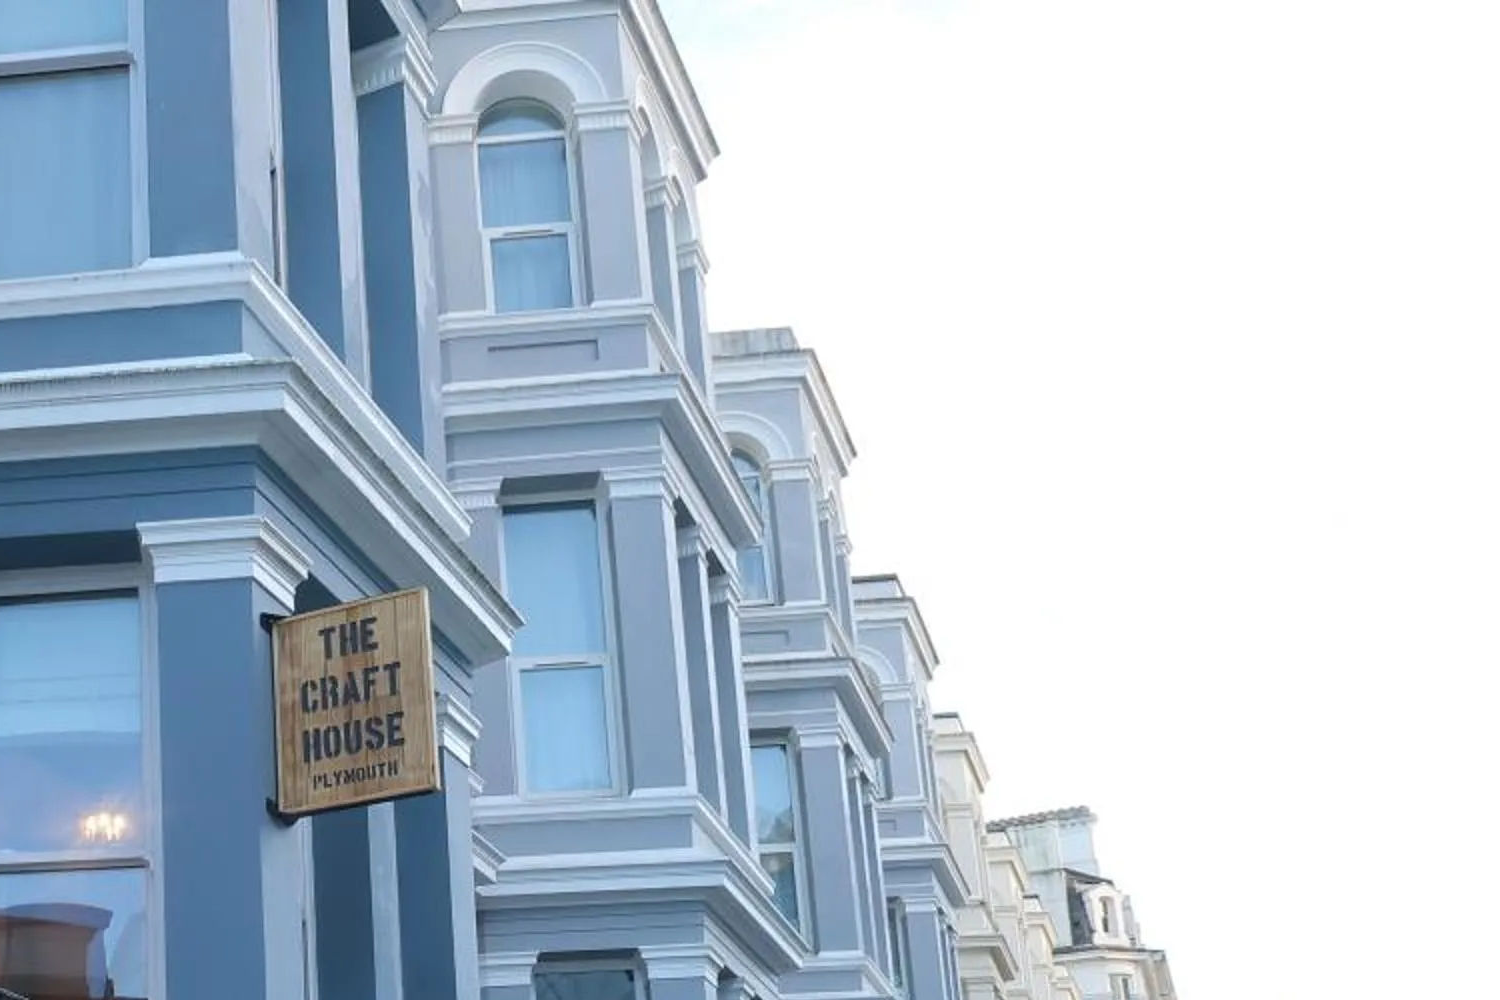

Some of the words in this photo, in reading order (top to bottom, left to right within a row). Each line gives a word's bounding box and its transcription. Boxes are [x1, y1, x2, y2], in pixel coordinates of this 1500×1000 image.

[318, 617, 379, 660] THE
[300, 661, 401, 714] CRAFT
[302, 711, 405, 765] HOUSE
[313, 759, 399, 790] PLYMOUTH
